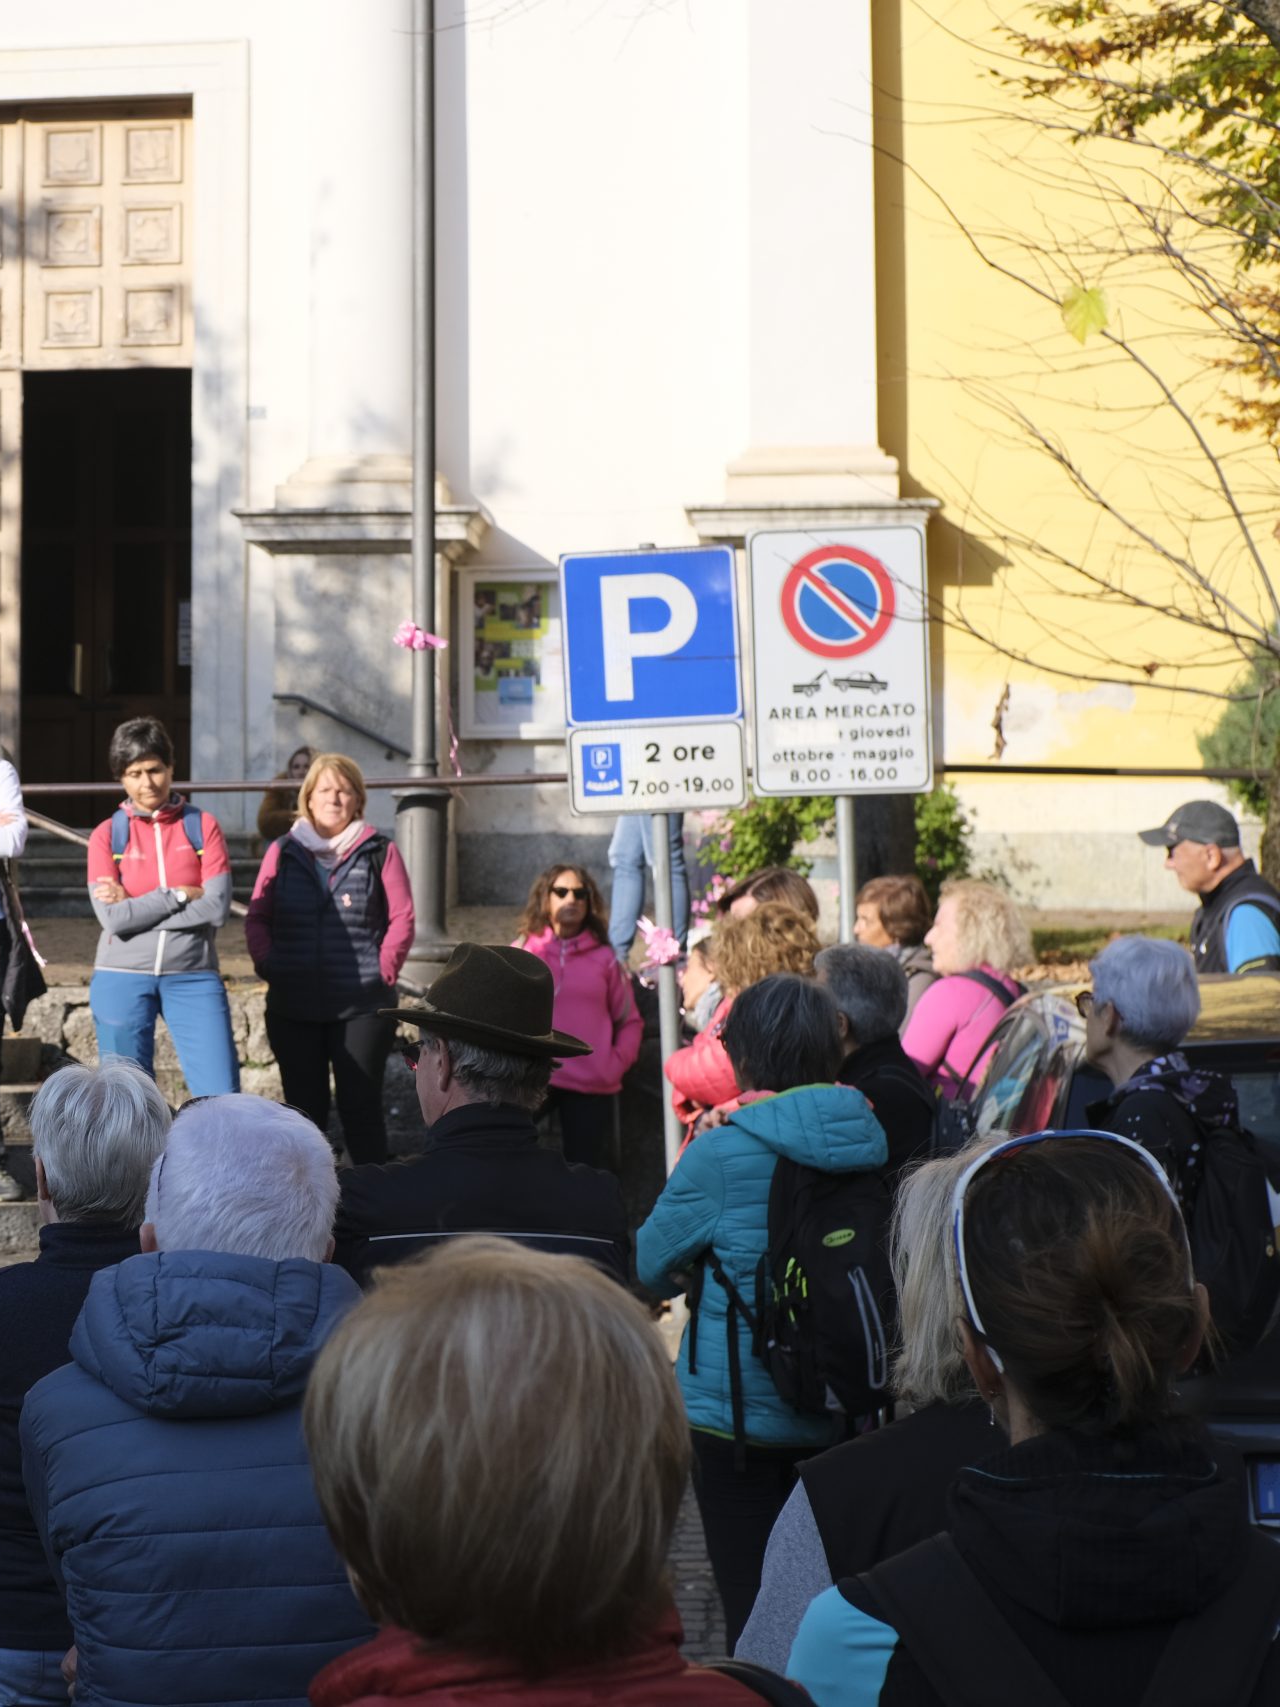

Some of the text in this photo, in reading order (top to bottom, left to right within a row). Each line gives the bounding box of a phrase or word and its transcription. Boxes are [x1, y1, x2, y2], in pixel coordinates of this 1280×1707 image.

[600, 573, 698, 702] P
[769, 703, 916, 720] AREA MERCATO
[645, 743, 715, 763] 2 ore
[772, 750, 835, 763] ottobre
[852, 746, 914, 761] maggio
[790, 769, 831, 784] 8.00
[850, 767, 898, 782] 16.00
